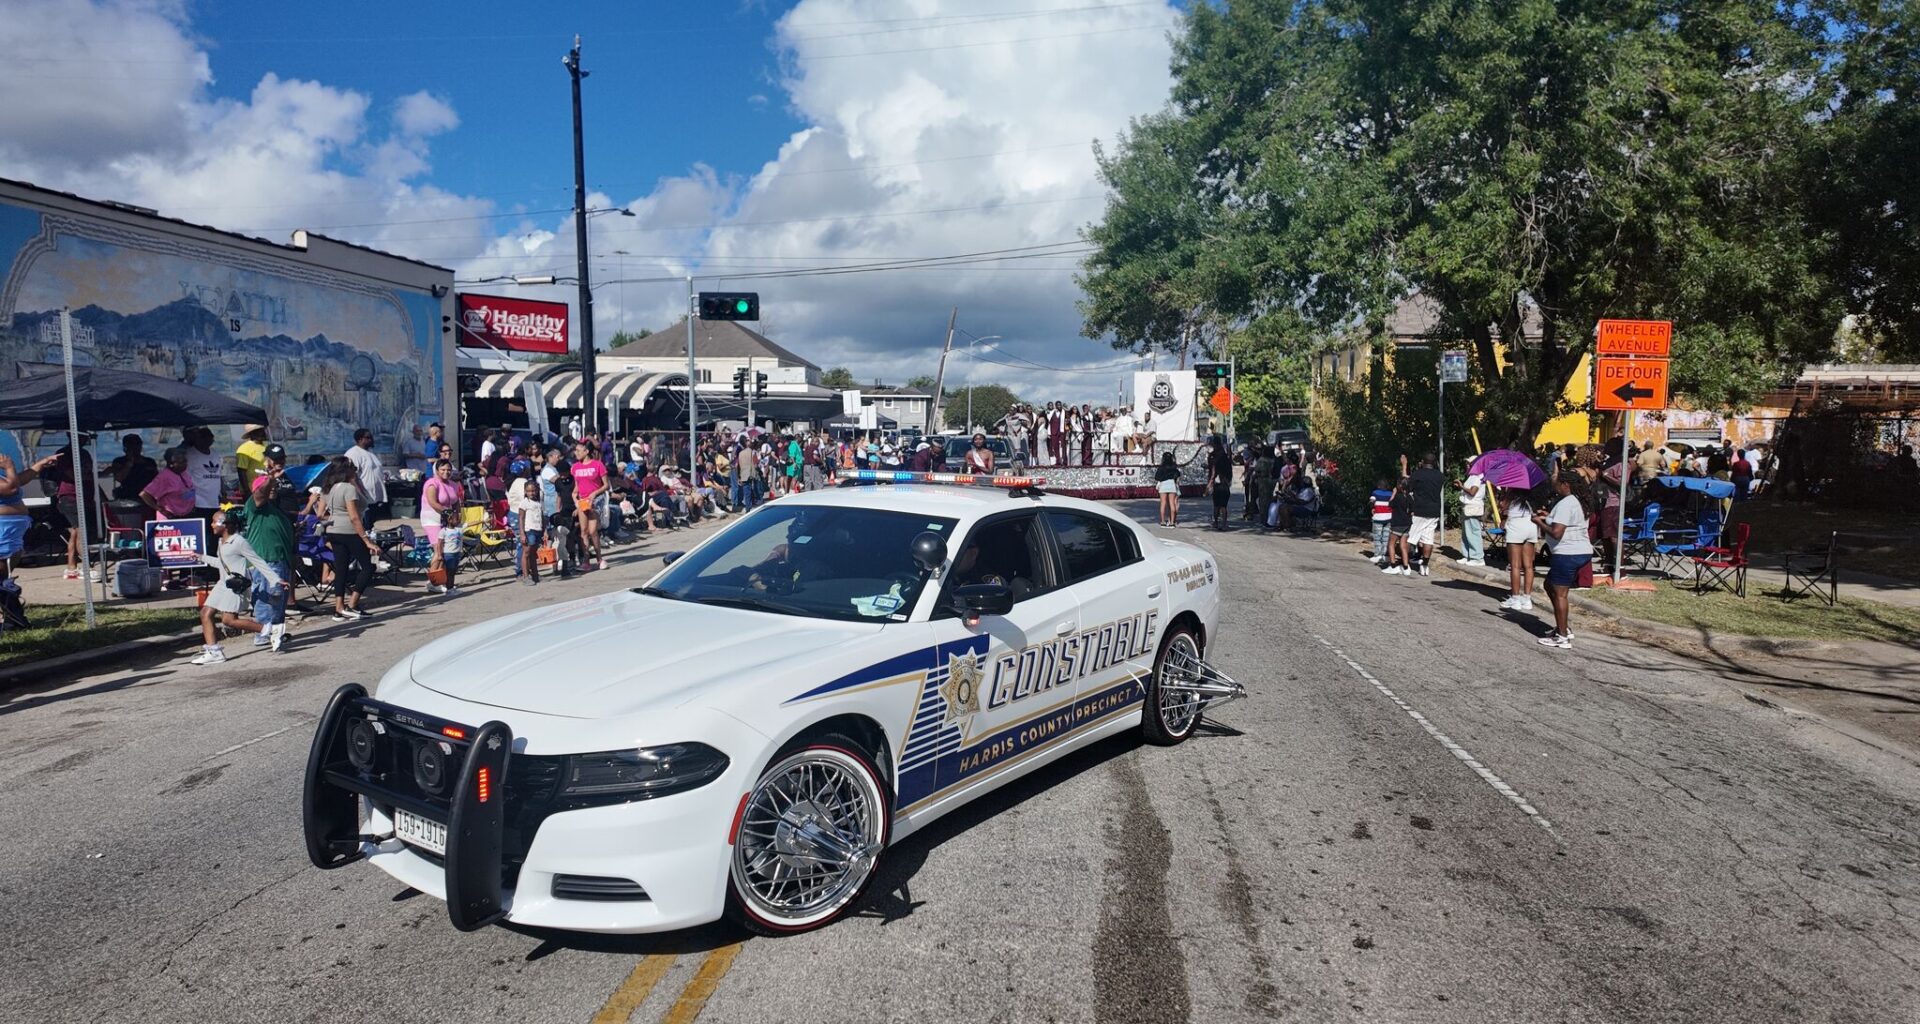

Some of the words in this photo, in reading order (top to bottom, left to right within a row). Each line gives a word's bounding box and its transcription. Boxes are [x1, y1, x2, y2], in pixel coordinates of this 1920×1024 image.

[230, 319, 241, 333] IS
[493, 309, 565, 332] Healthy
[492, 322, 553, 338] STRIDES
[1605, 324, 1665, 337] WHEELER
[1608, 340, 1660, 352] AVENUE
[1606, 366, 1662, 379] DETOUR
[1156, 384, 1169, 397] 98
[1106, 468, 1135, 476] TSU
[154, 535, 197, 552] PEAKE
[987, 608, 1158, 712] CONSTABLE
[396, 713, 425, 729] SETINA
[959, 737, 1014, 773] HARRIS
[1020, 713, 1070, 746] COUNTY
[1076, 687, 1132, 722] PRECINCT
[1135, 684, 1141, 697] 7
